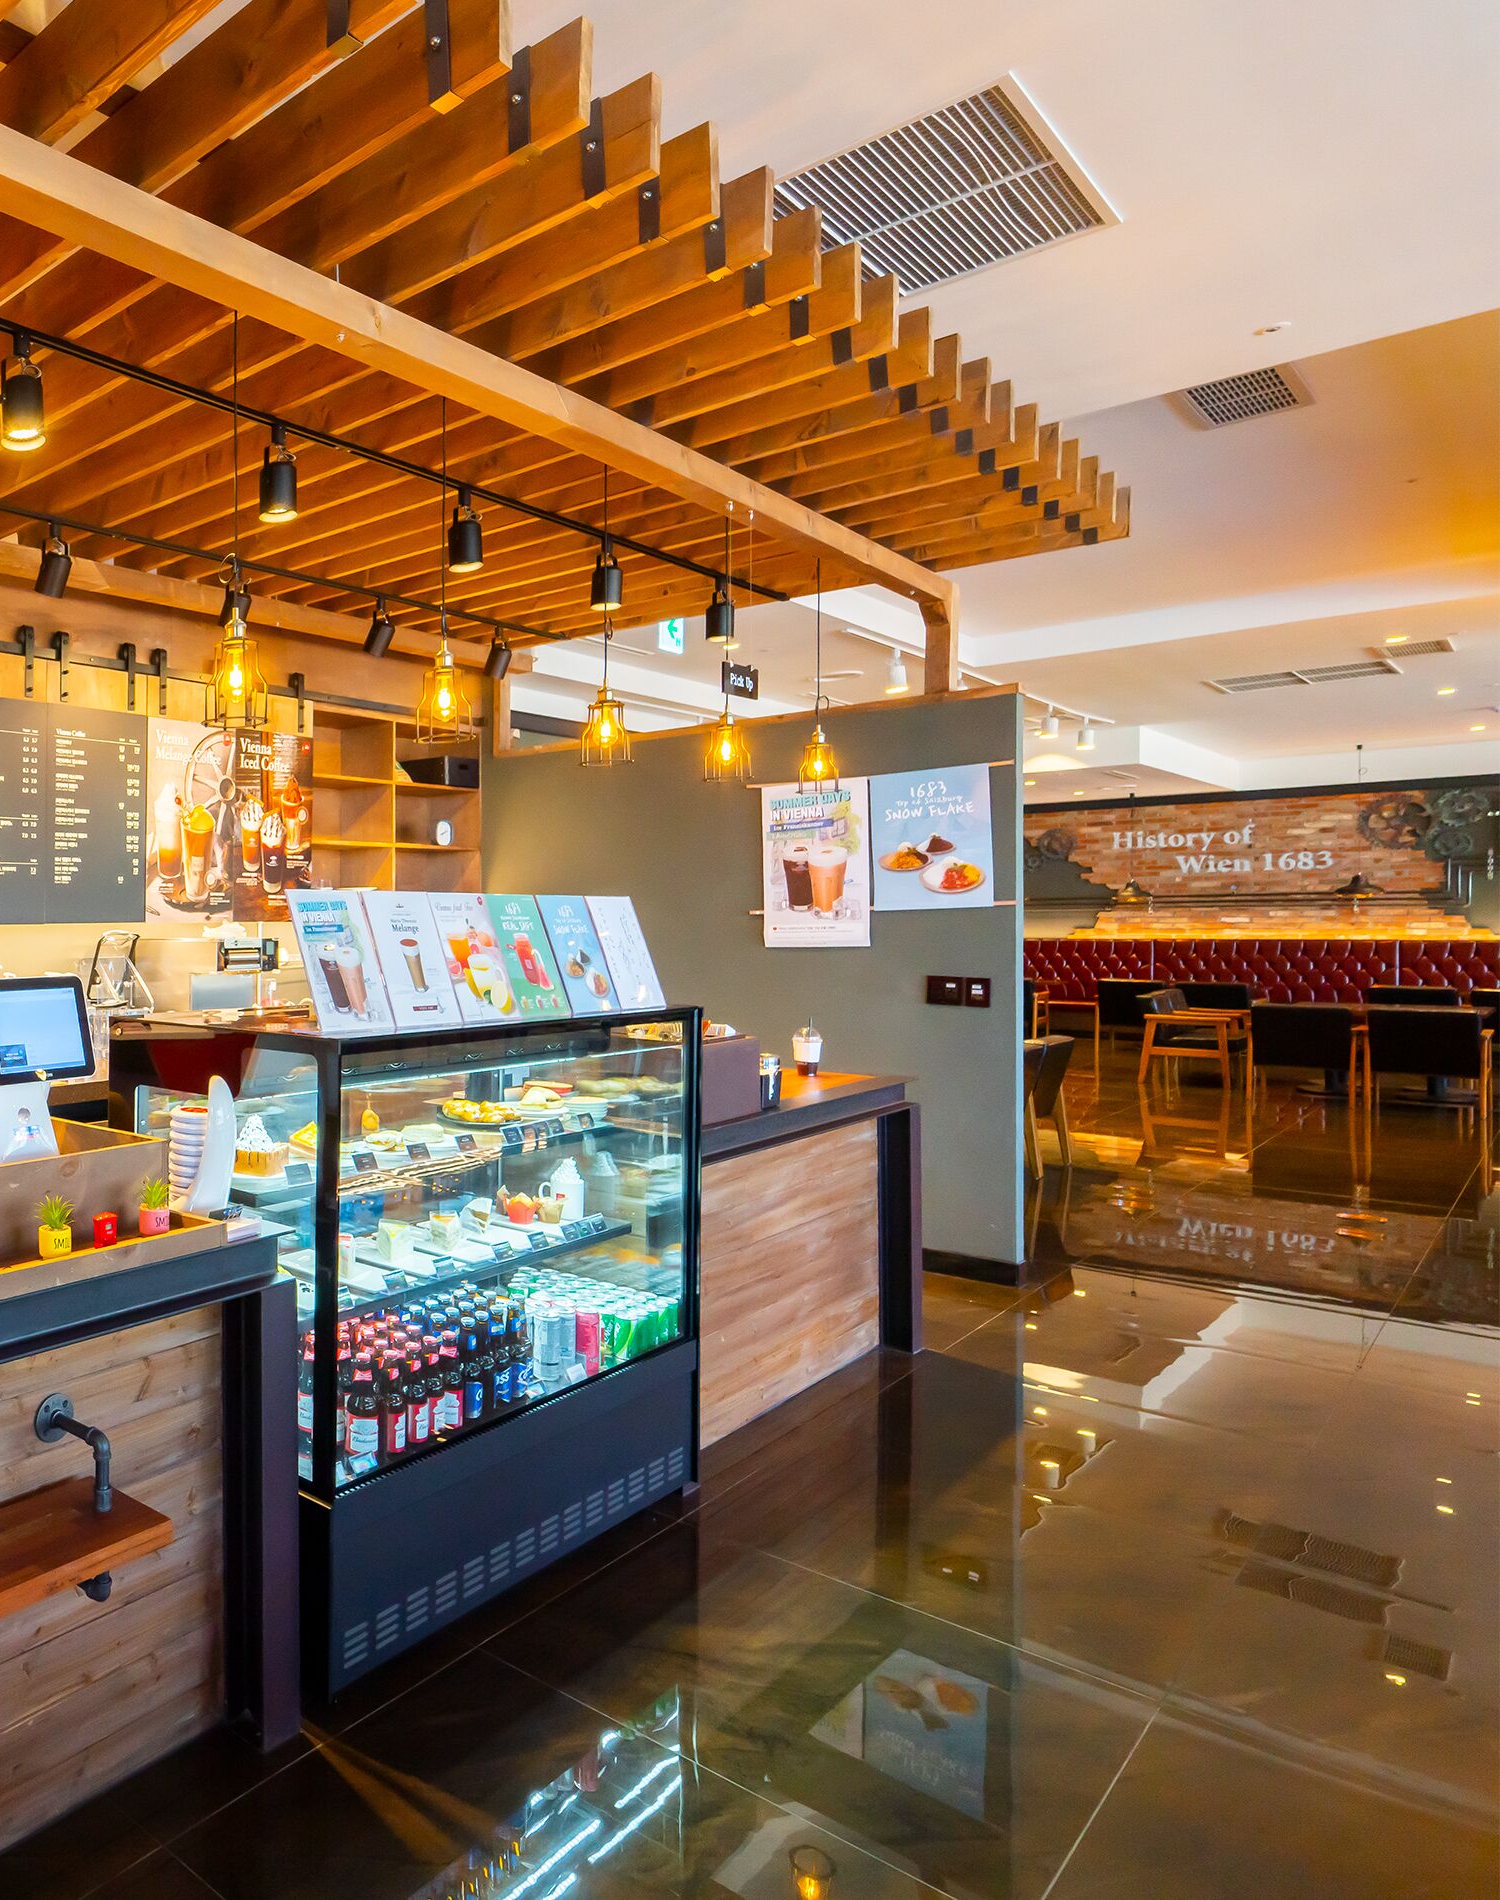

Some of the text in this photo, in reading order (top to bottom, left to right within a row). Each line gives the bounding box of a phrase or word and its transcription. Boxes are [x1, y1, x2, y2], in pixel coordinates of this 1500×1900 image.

[729, 672, 754, 691] Pick Up
[156, 729, 189, 746] Vienna
[240, 738, 272, 755] Vienna
[240, 754, 290, 772] Iced Coffee
[910, 780, 947, 798] 1683
[770, 790, 851, 810] SUMMER DAYS
[771, 807, 825, 821] IN VIENNA
[885, 801, 975, 822] SNOW FLAKE
[1113, 819, 1255, 851] History of
[1176, 850, 1334, 874] Wien 1683
[391, 924, 419, 934] Melange
